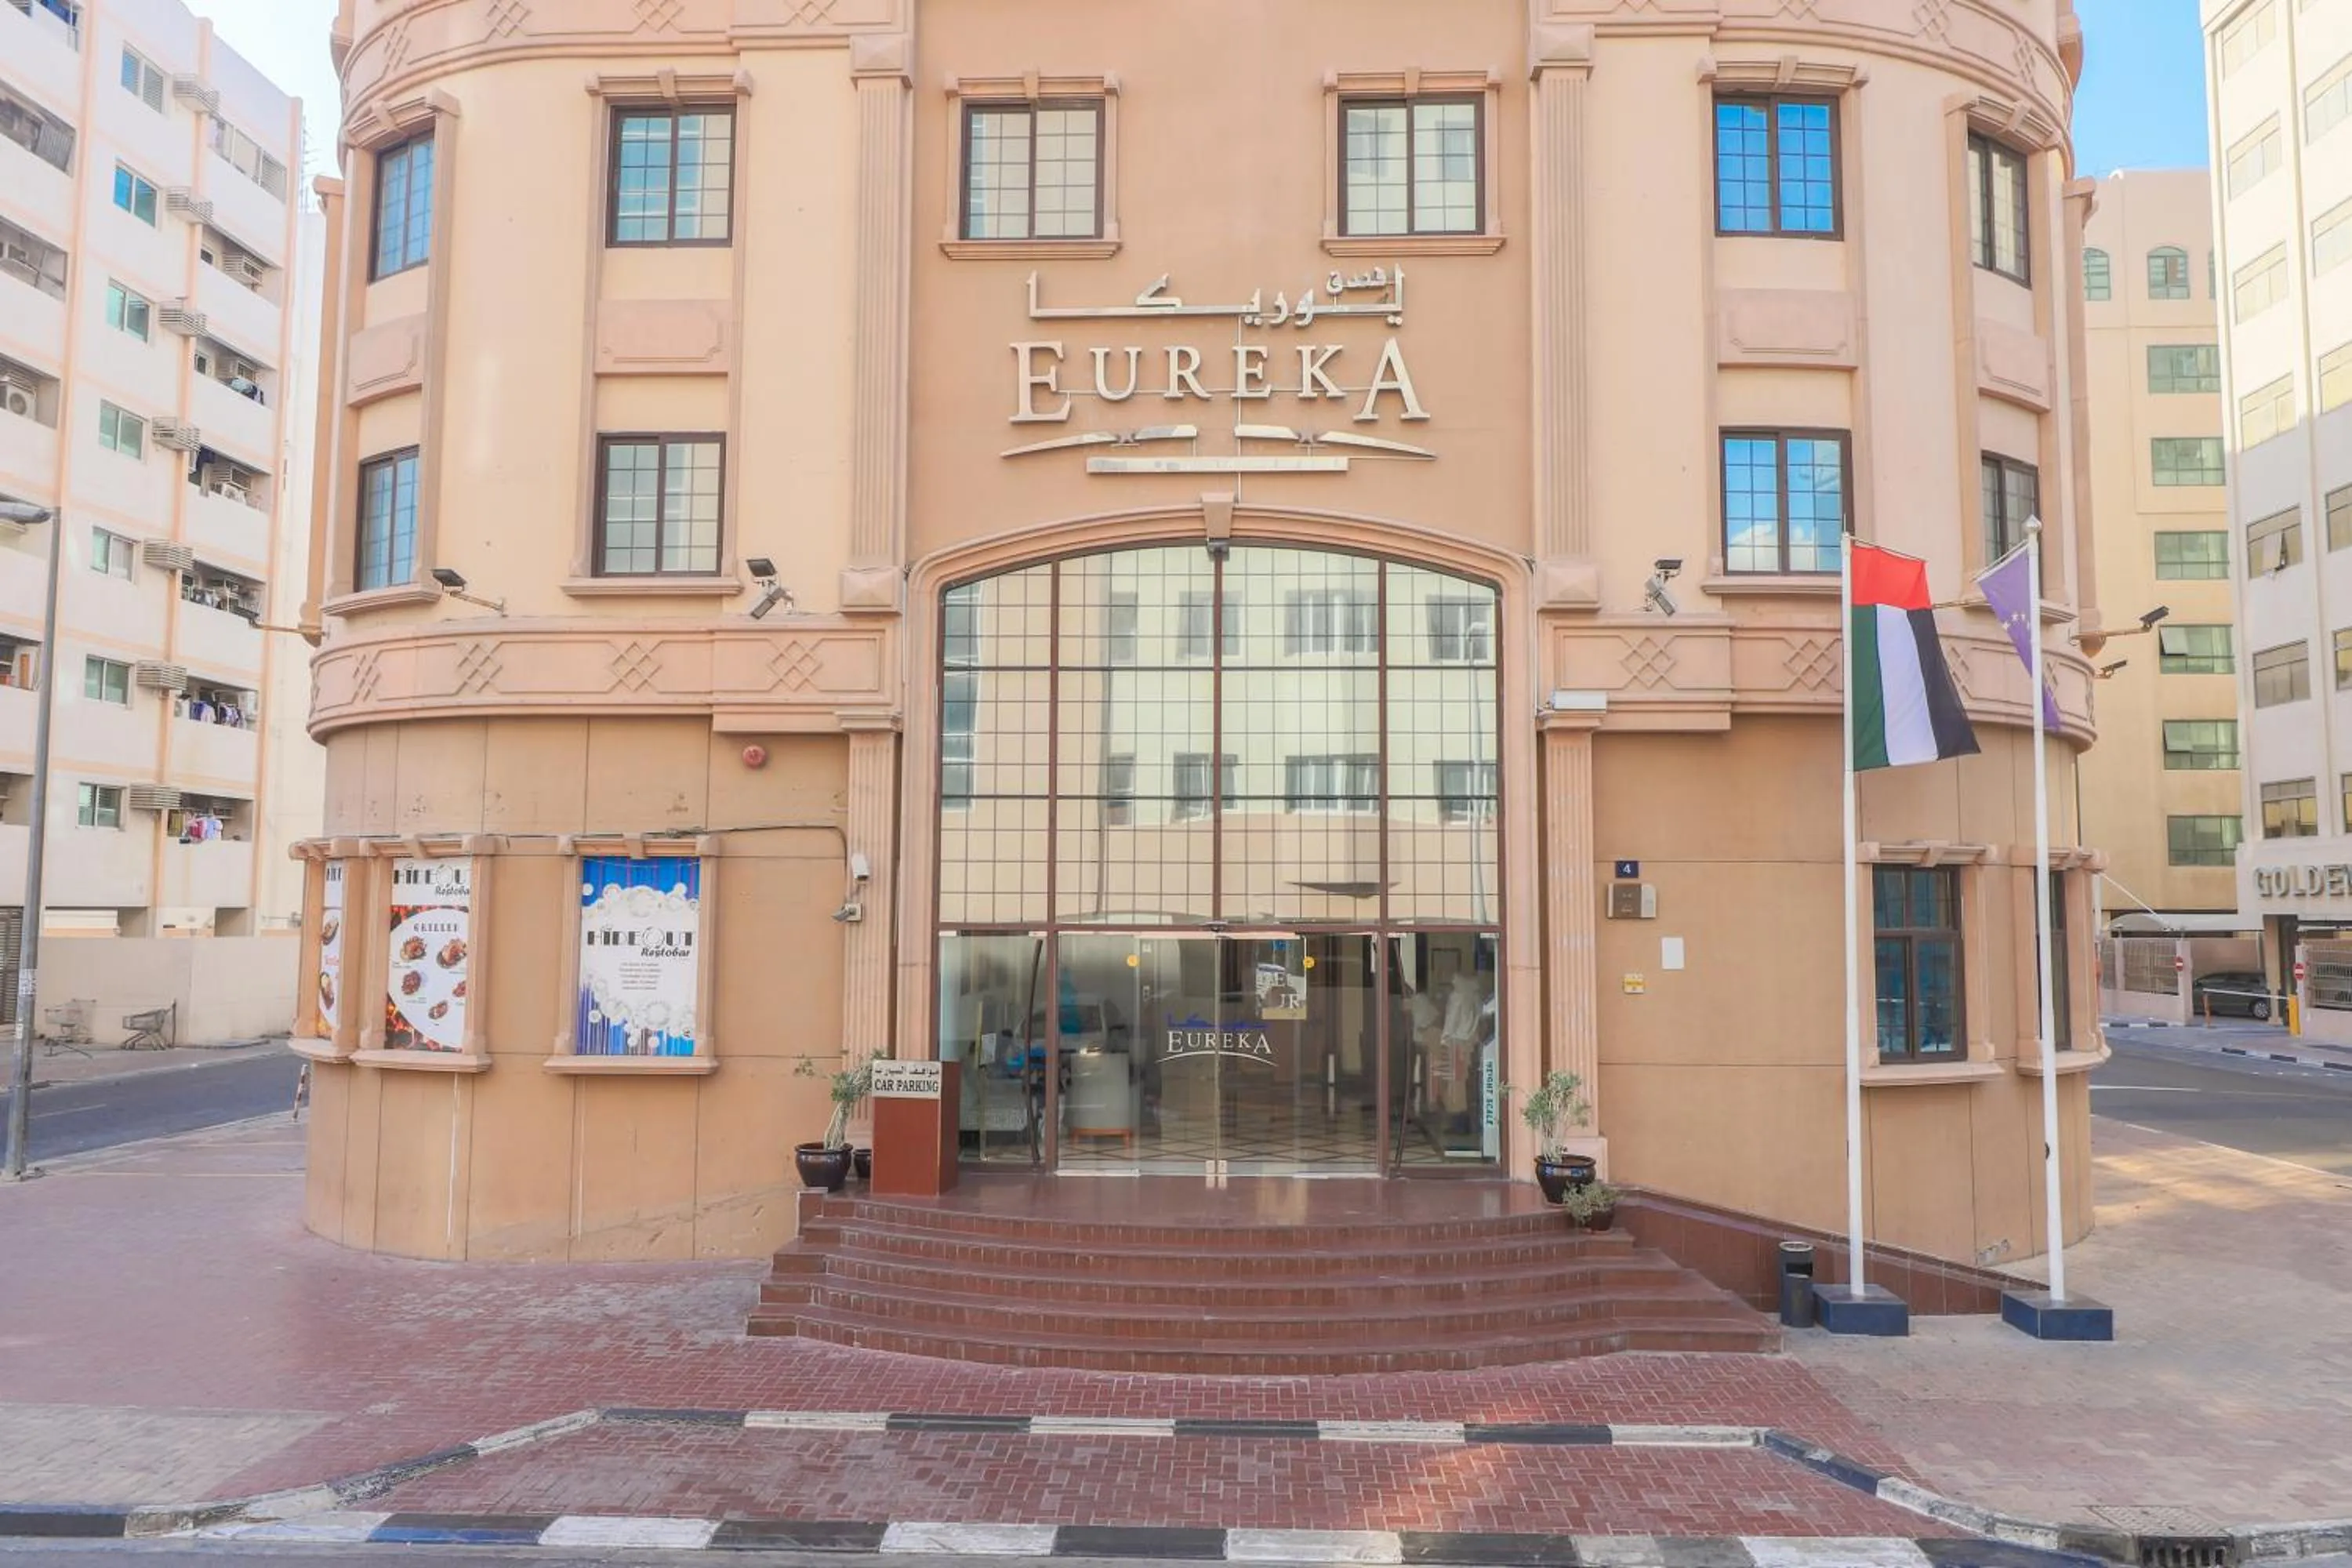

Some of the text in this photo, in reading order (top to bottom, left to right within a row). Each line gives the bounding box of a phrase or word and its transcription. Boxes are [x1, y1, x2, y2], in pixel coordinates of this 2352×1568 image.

[1009, 336, 1430, 423] EUREKA
[1622, 863, 1632, 874] 4
[587, 927, 695, 947] HIDEOUT
[1167, 1030, 1272, 1054] EUREKA
[874, 1079, 939, 1092] CAR PARKING
